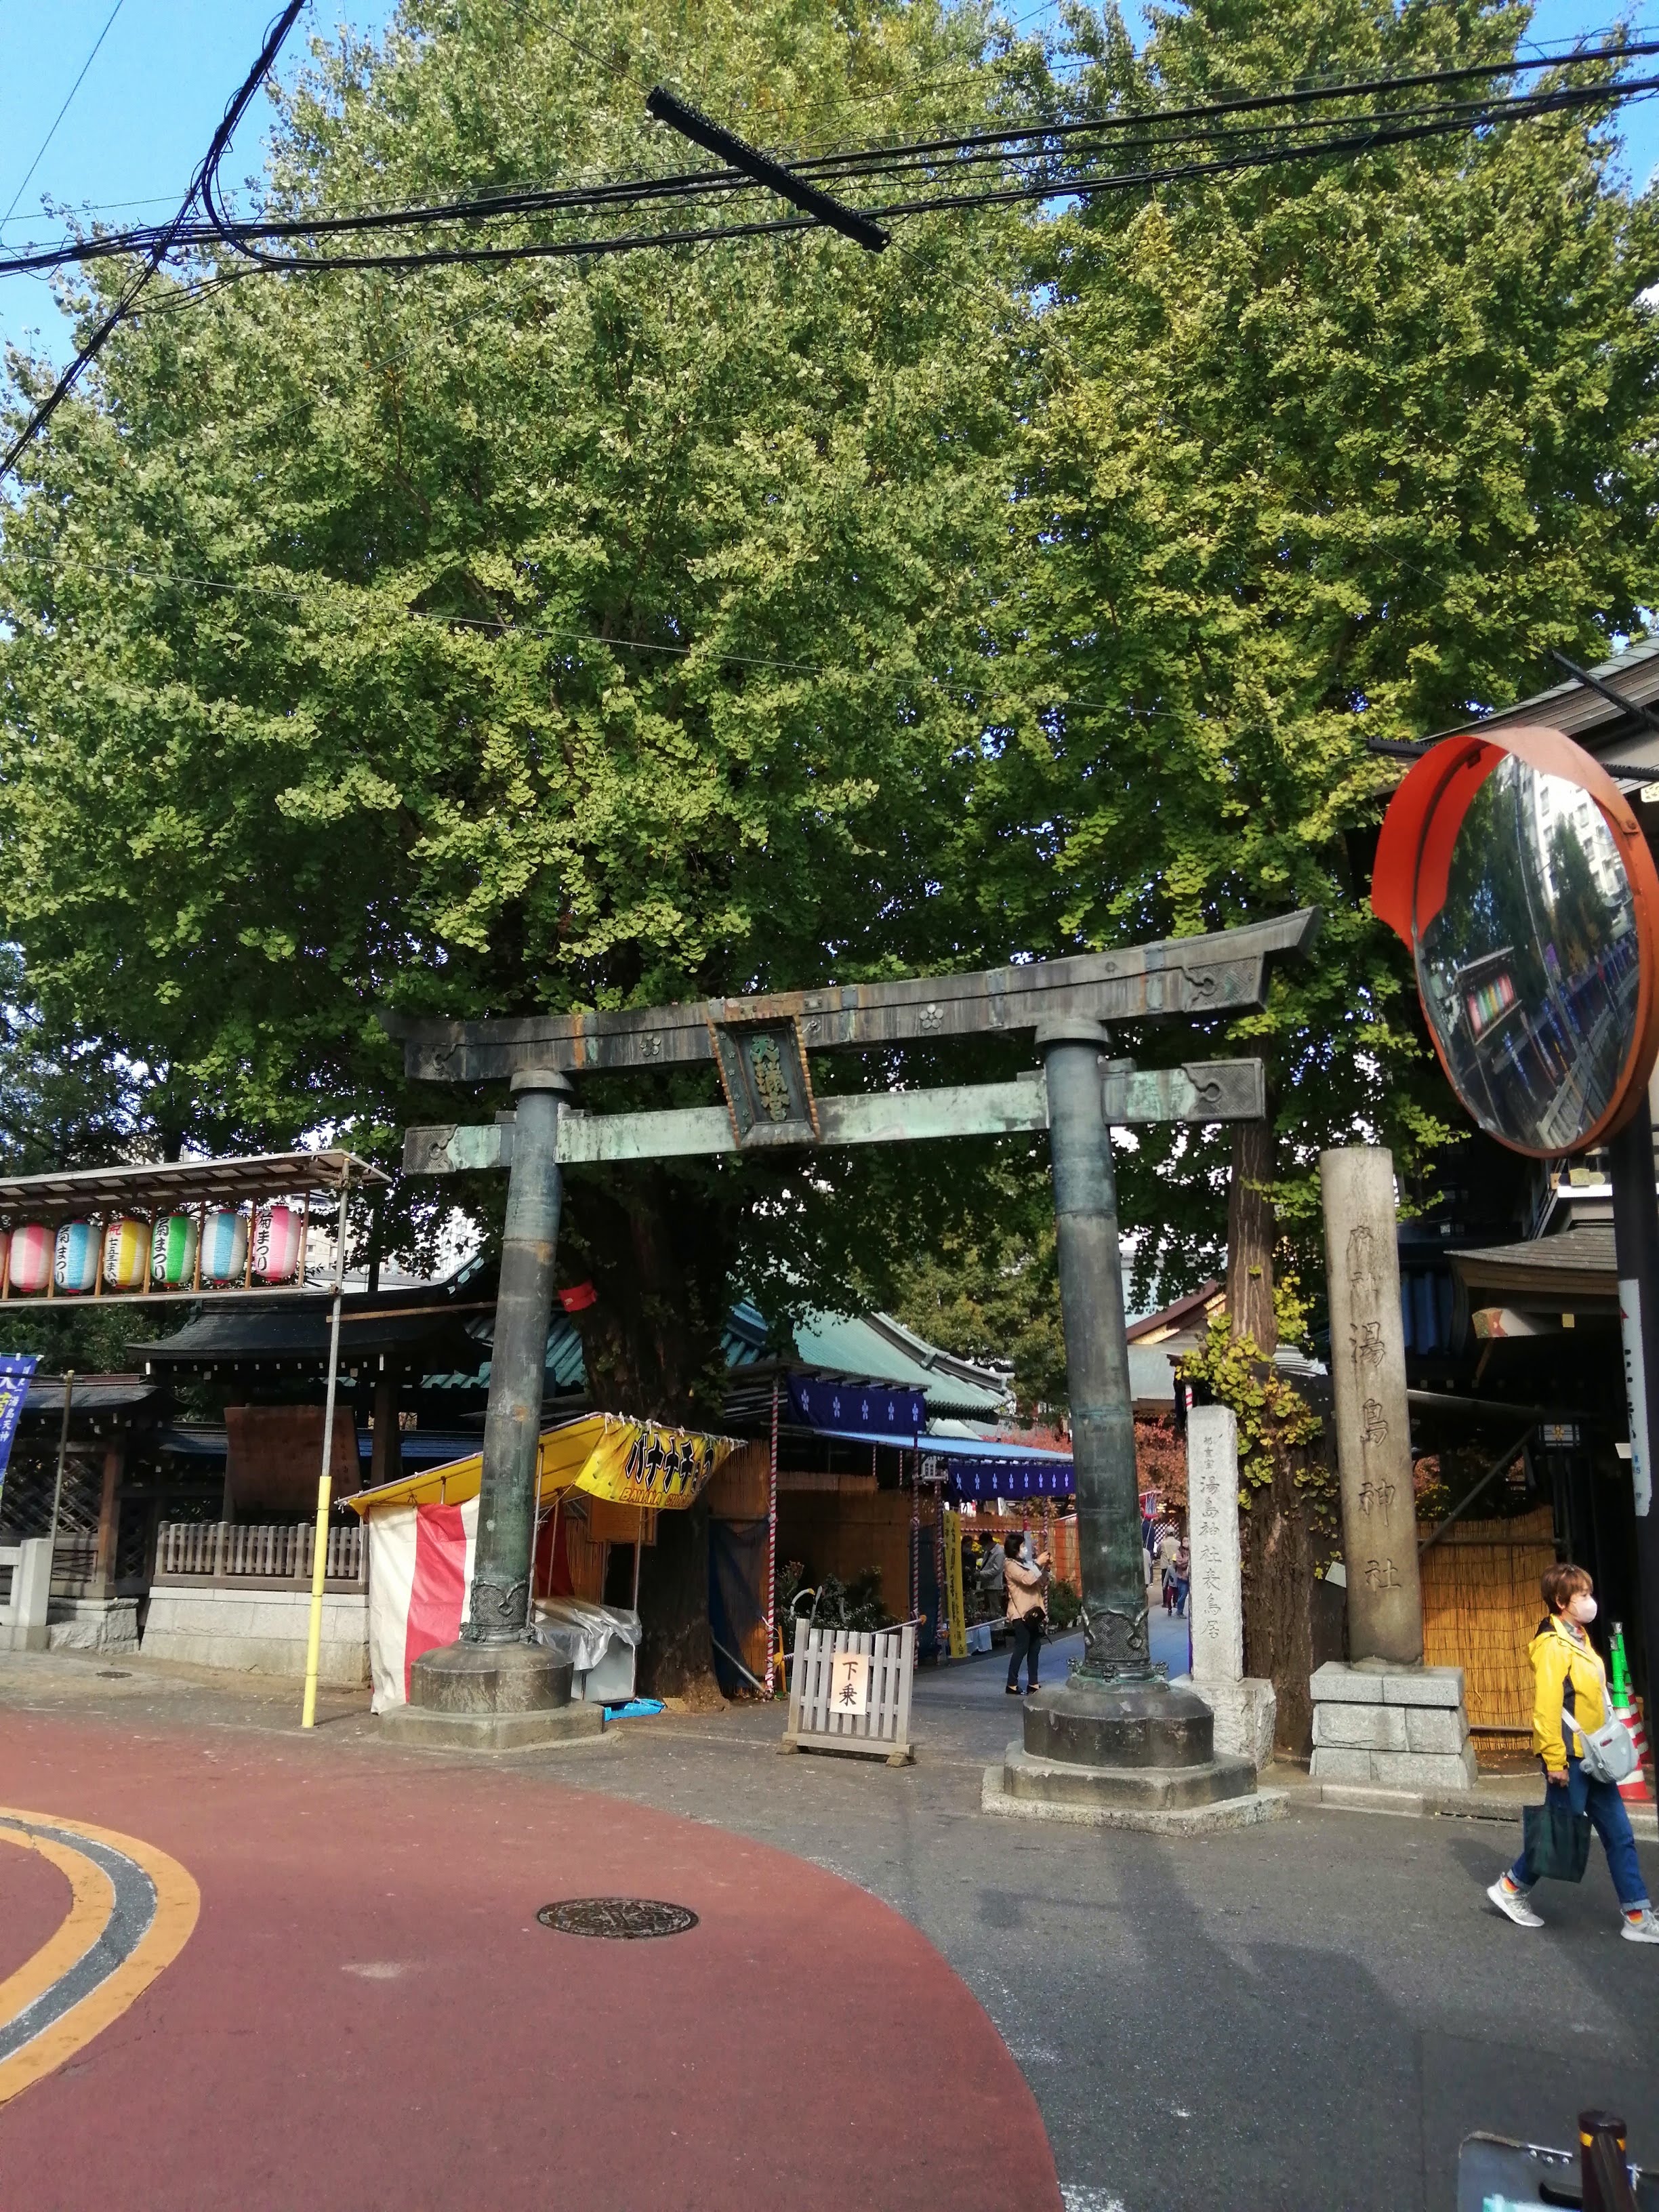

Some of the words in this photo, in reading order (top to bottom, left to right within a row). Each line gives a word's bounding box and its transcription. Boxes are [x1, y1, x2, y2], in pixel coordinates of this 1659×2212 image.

[109, 1224, 122, 1236] 祝
[153, 1218, 169, 1281] 菊まつり
[256, 1210, 274, 1271] 菊まつり
[56, 1227, 70, 1284] 菊まつり
[106, 1237, 119, 1285] 七五三まいり
[619, 1487, 663, 1505] BANANA
[839, 1661, 859, 1706] 下乗
